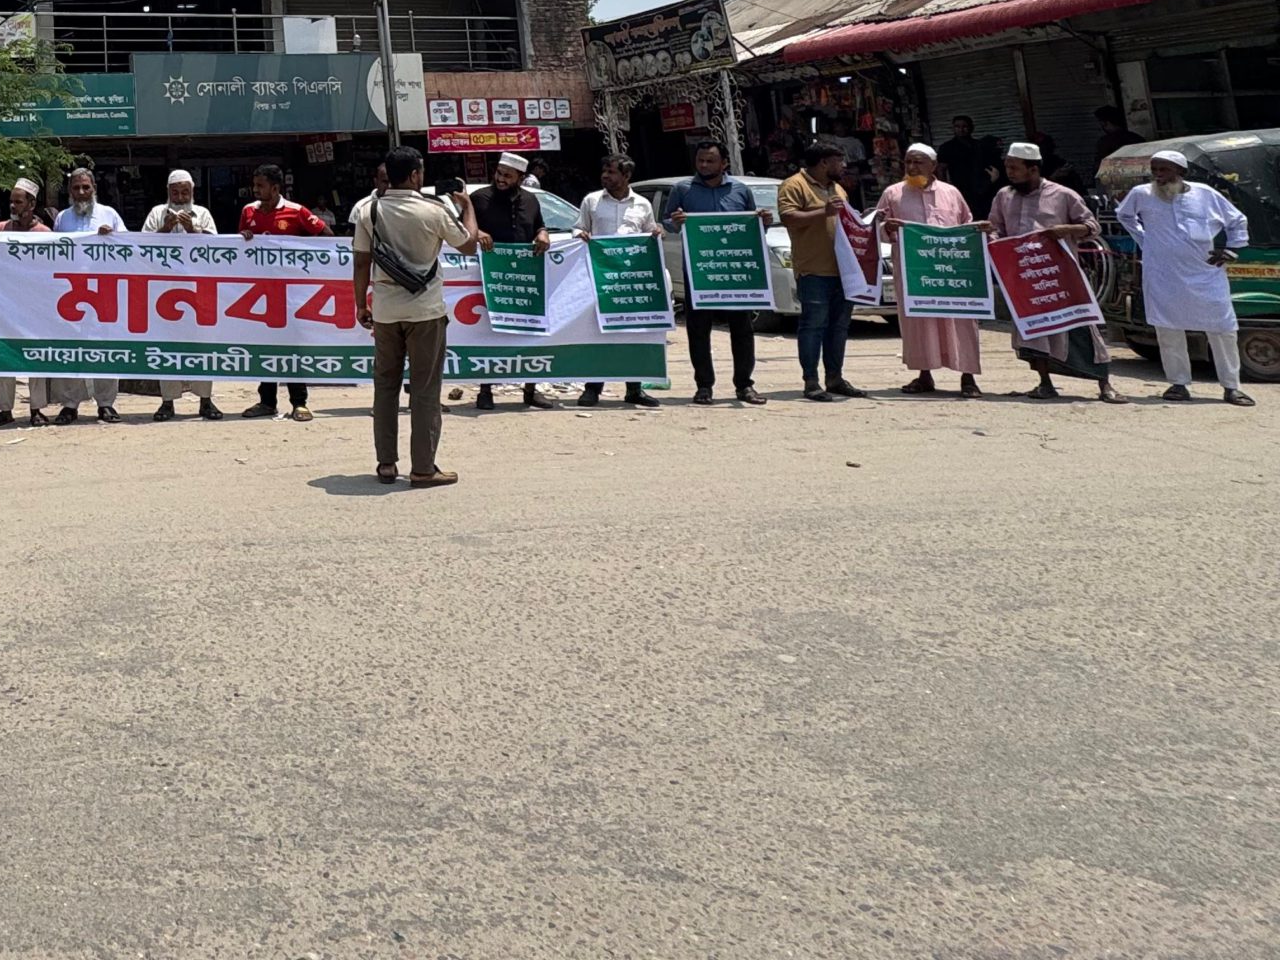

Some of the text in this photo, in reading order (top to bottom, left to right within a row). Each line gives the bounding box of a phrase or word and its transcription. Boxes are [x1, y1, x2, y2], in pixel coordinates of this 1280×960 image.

[196, 75, 343, 97] সোনালী ব্যাংক পিএলসি
[921, 234, 967, 247] পাচারকৃত
[6, 237, 331, 274] ইসলামী ব্যাংক সমূহ থেকে পাচারকৃত
[917, 247, 971, 259] অর্থ ফিরিয়ে
[934, 264, 957, 274] দাও,
[920, 275, 945, 288] দিতে
[21, 346, 555, 375] আয়োজনে: ইসলামী ব্যাংক সমাজ
